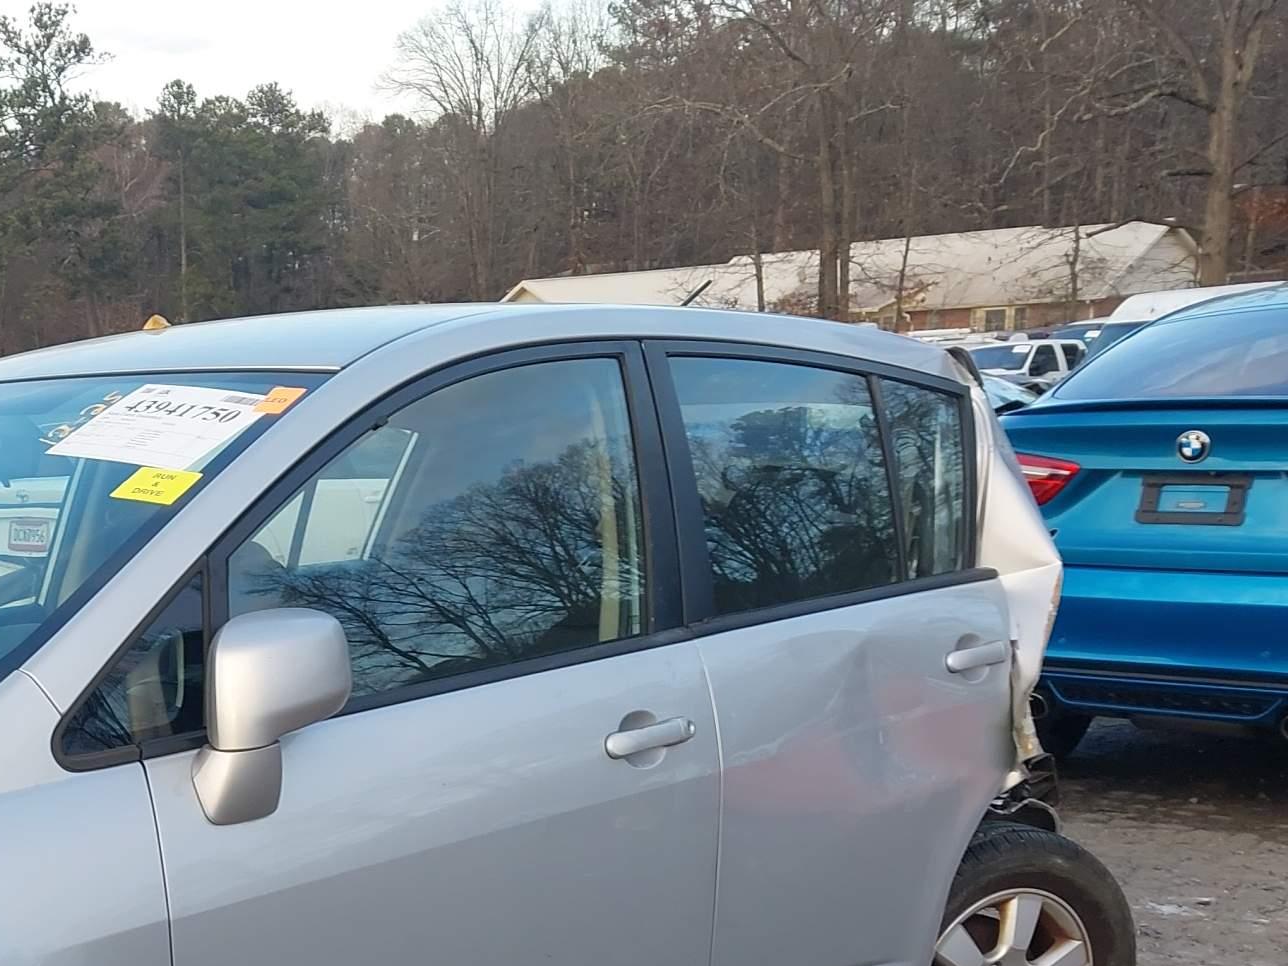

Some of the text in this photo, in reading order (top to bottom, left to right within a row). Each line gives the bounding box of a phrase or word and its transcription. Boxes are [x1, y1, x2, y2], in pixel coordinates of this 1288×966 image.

[124, 399, 242, 423] 43941750
[152, 472, 177, 480] RUN
[131, 487, 165, 496] DRIVE
